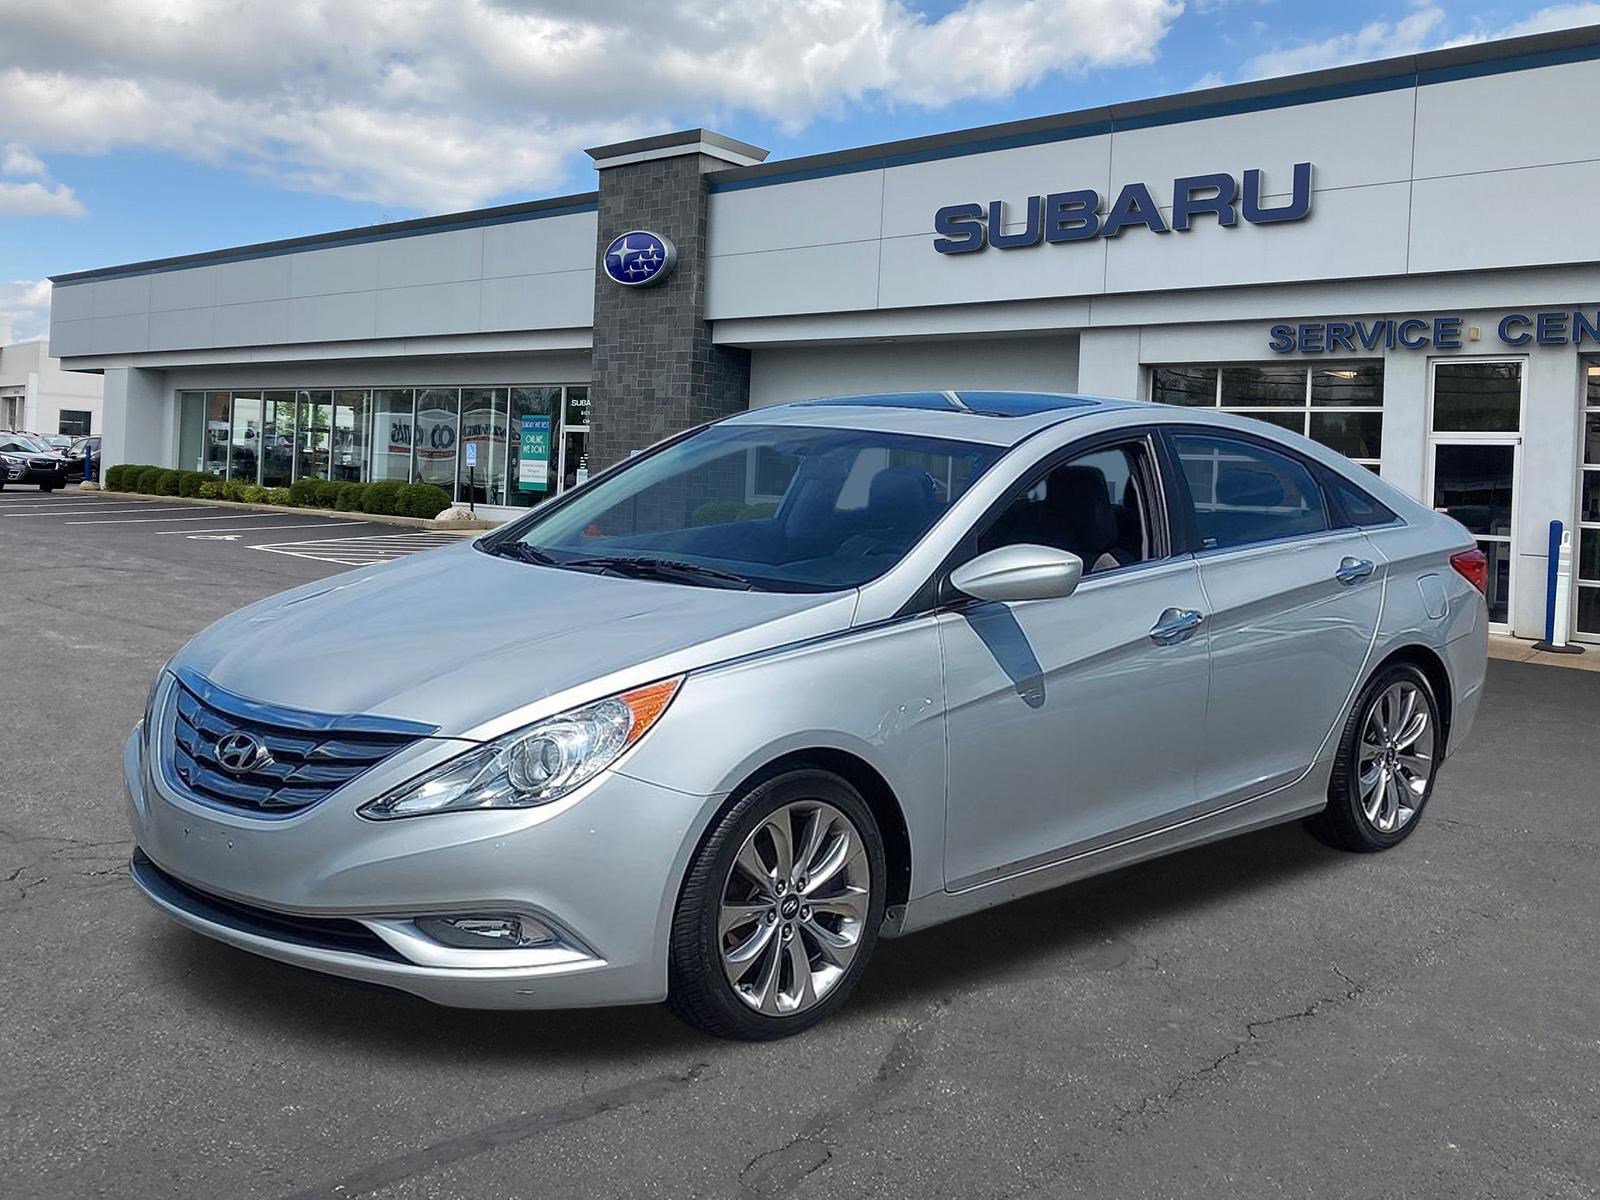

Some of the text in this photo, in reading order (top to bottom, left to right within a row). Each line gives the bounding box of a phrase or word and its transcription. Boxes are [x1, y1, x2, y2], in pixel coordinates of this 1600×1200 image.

[934, 162, 1313, 255] SUBARU
[1268, 311, 1600, 352] SERVICE CEN
